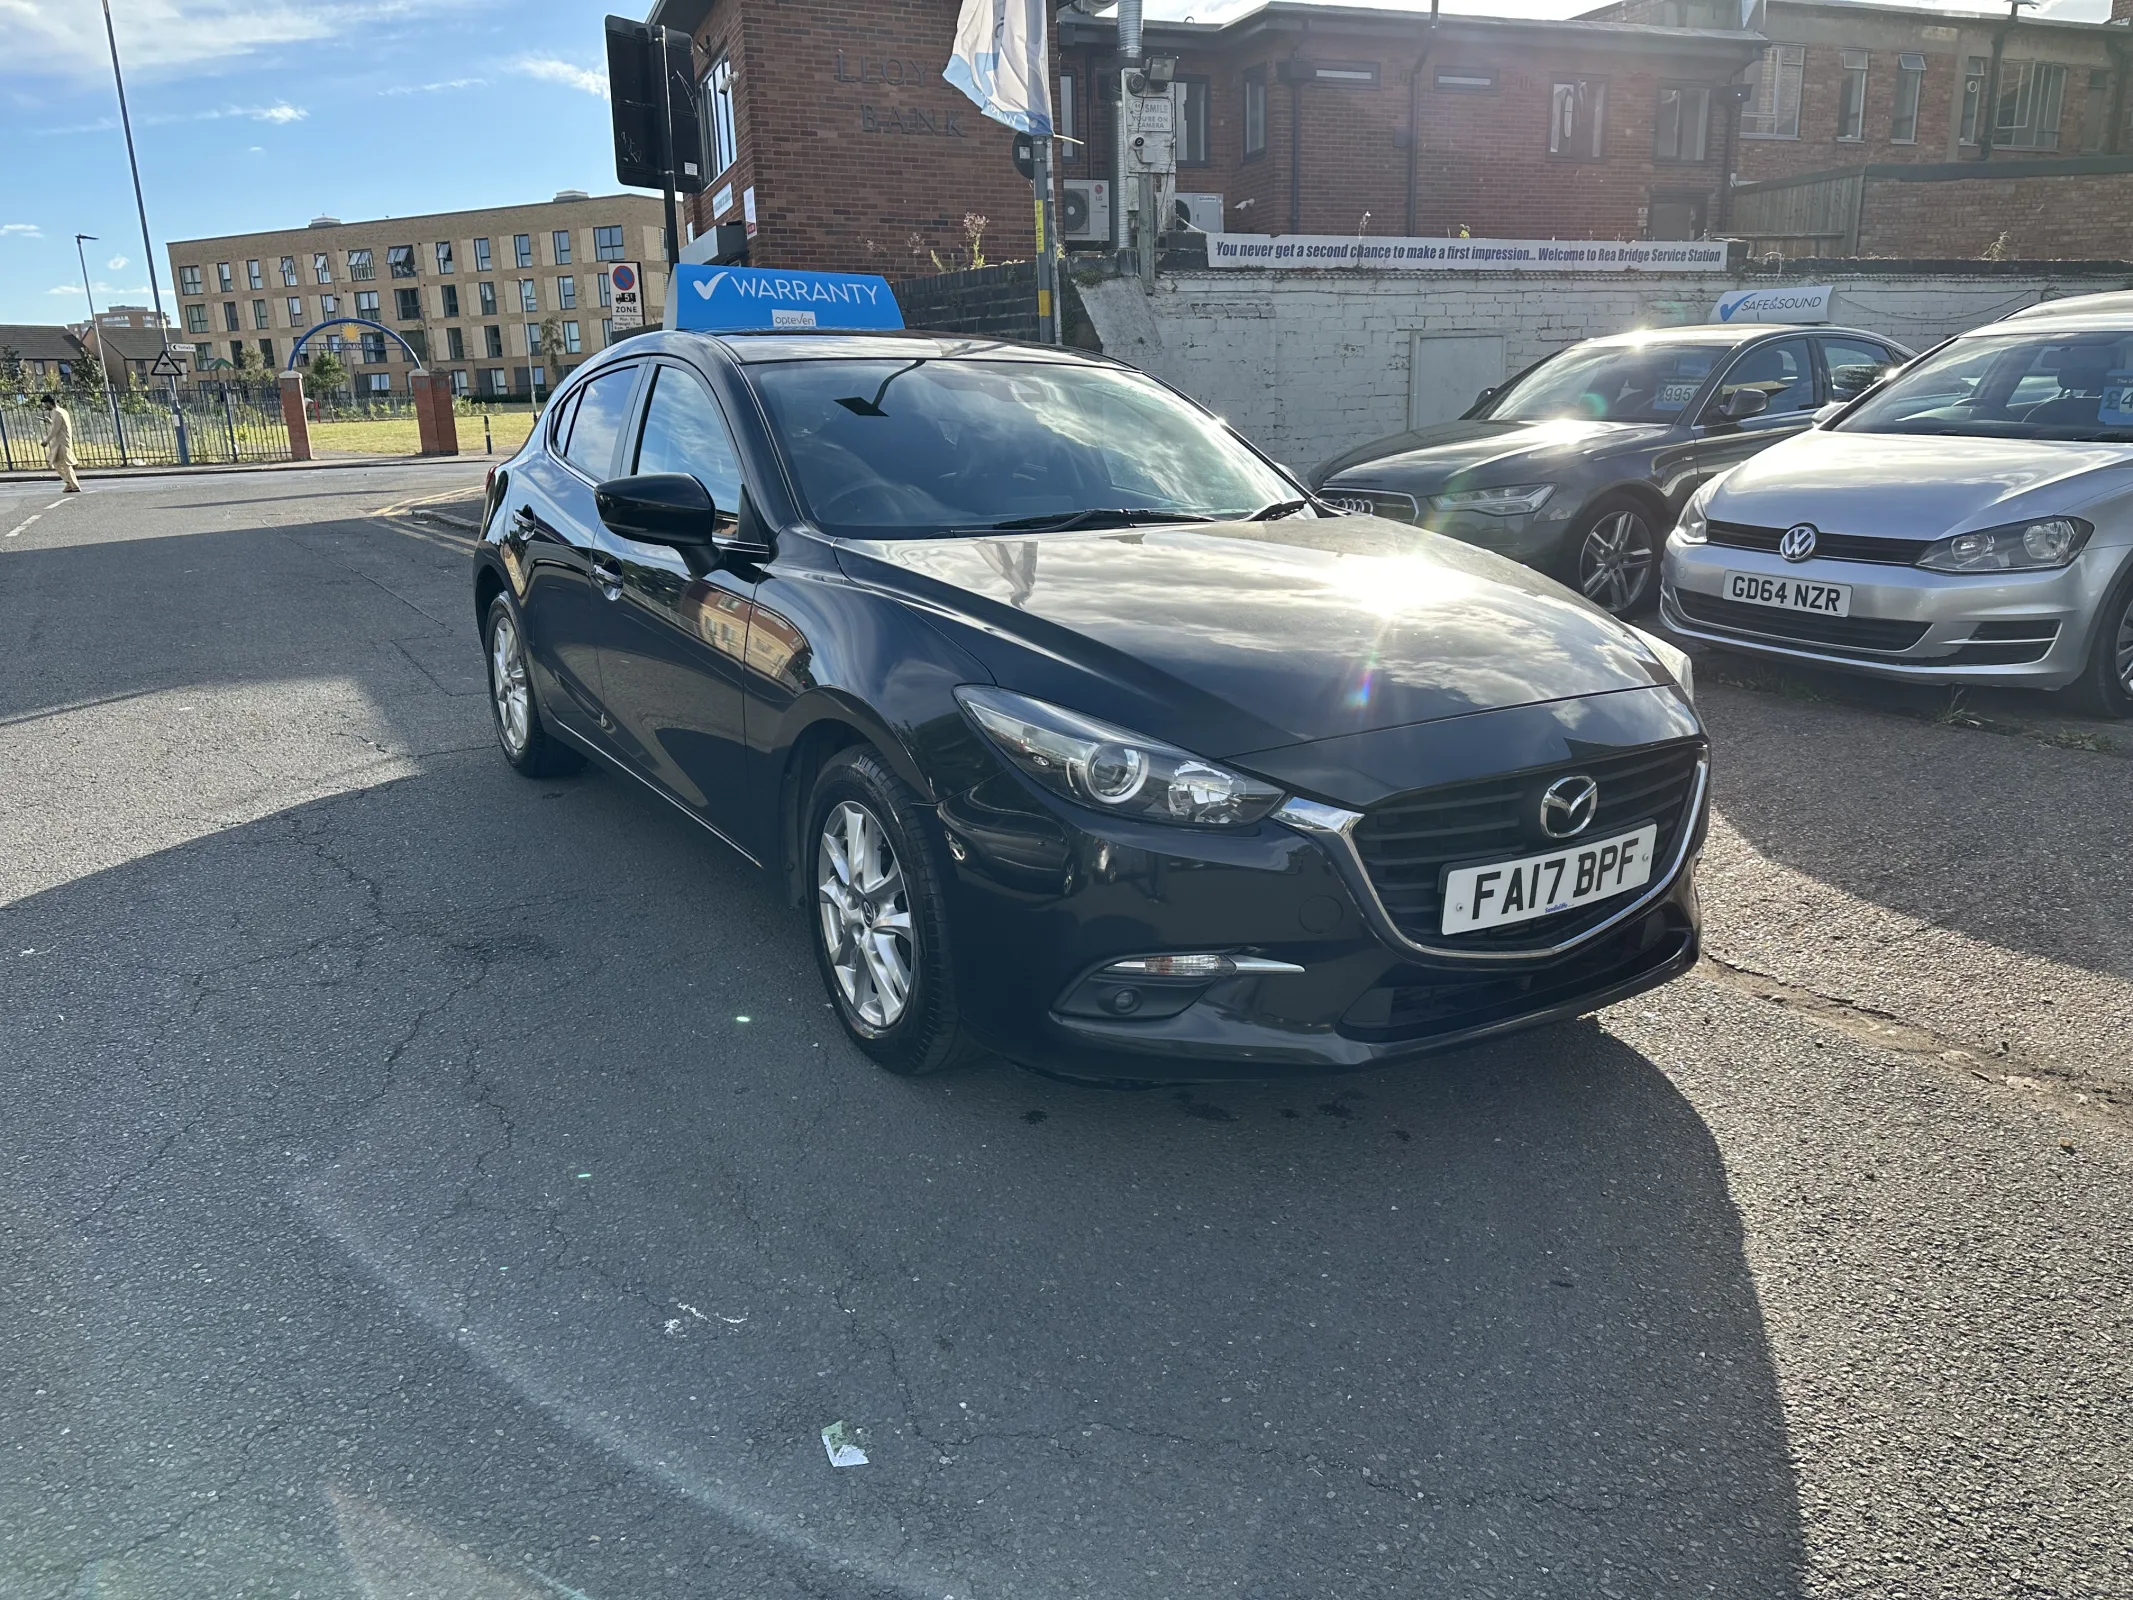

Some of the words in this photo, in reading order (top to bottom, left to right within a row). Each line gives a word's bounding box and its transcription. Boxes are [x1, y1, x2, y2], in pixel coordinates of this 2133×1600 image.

[861, 104, 968, 137] BANK
[1145, 103, 1168, 113] SMILE
[1217, 241, 1238, 256] You
[1239, 244, 1274, 257] never
[1275, 243, 1295, 259] get
[1296, 245, 1304, 257] a
[1306, 243, 1349, 258] second
[1350, 243, 1391, 258] chance
[1393, 245, 1405, 258] to
[1406, 245, 1437, 259] make
[1438, 247, 1446, 259] a
[1447, 246, 1470, 260] first
[1471, 245, 1536, 261] impression...
[1538, 247, 1585, 261] Welcome
[1586, 248, 1597, 261] to
[1598, 248, 1617, 261] Rea
[1617, 248, 1650, 263] Bridge
[1651, 248, 1689, 262] Service
[1687, 248, 1721, 262] Station
[731, 276, 878, 305] WARRANTY
[1741, 296, 1822, 311] SAFE&SOUND
[774, 313, 814, 327] opteven
[1732, 576, 1788, 604] GD64
[1793, 584, 1841, 612] NZR
[1471, 857, 1567, 920] FA17
[1572, 837, 1640, 898] BPF
